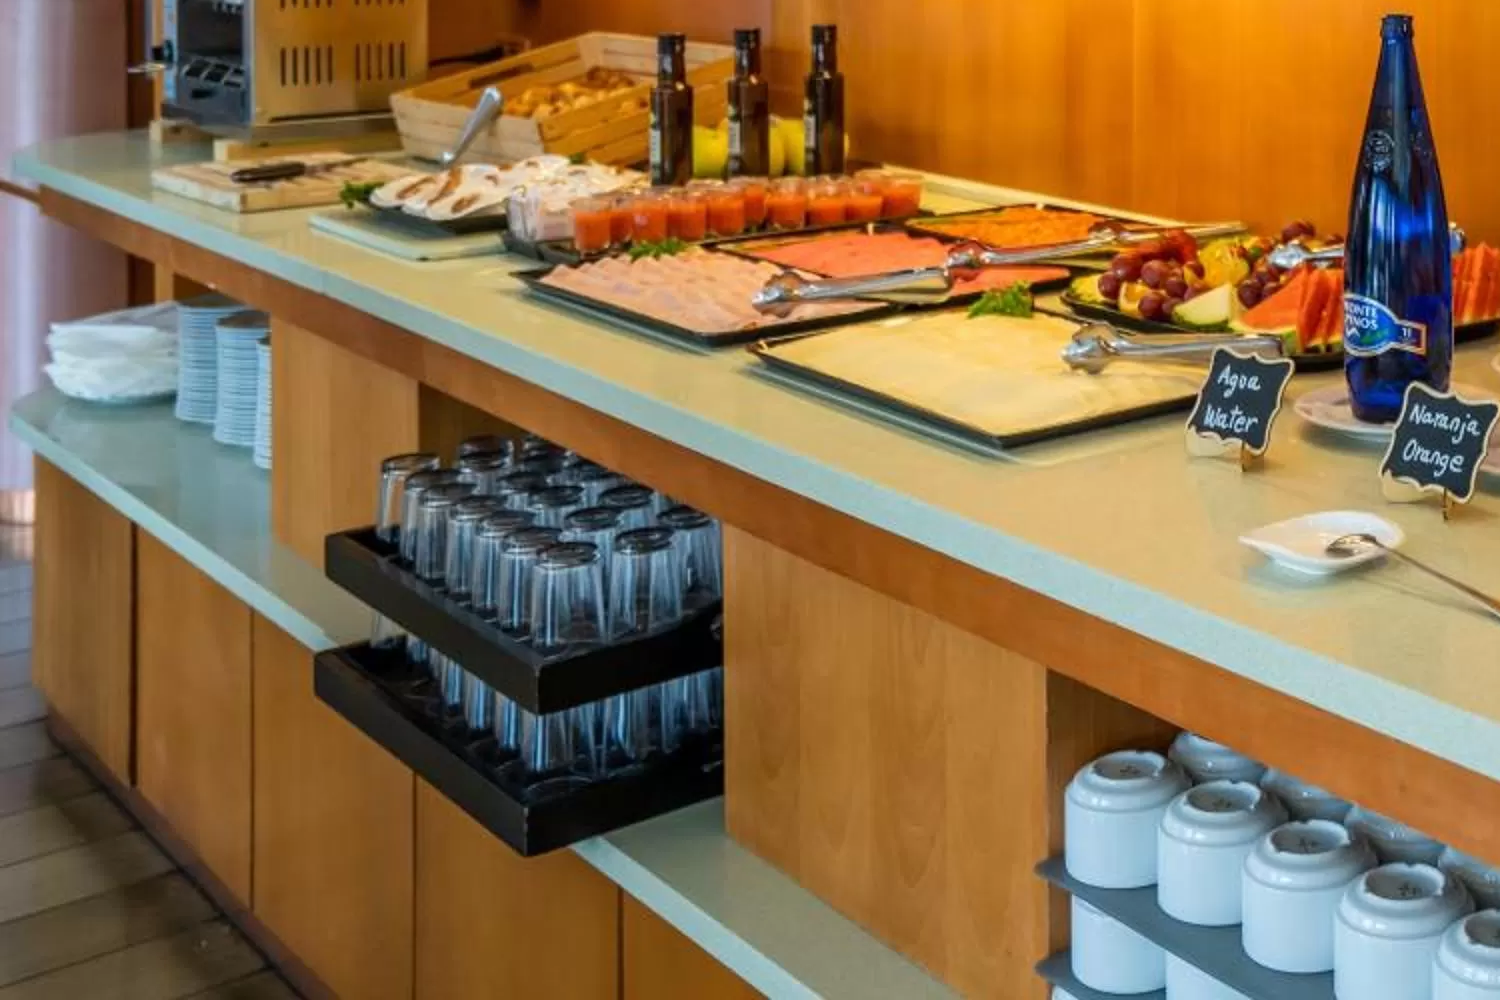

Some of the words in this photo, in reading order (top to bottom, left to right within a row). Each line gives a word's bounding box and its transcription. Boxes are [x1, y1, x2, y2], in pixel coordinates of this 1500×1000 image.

[1203, 404, 1258, 433] Water
[1409, 402, 1480, 445] Naranja
[1402, 438, 1464, 477] Orange
